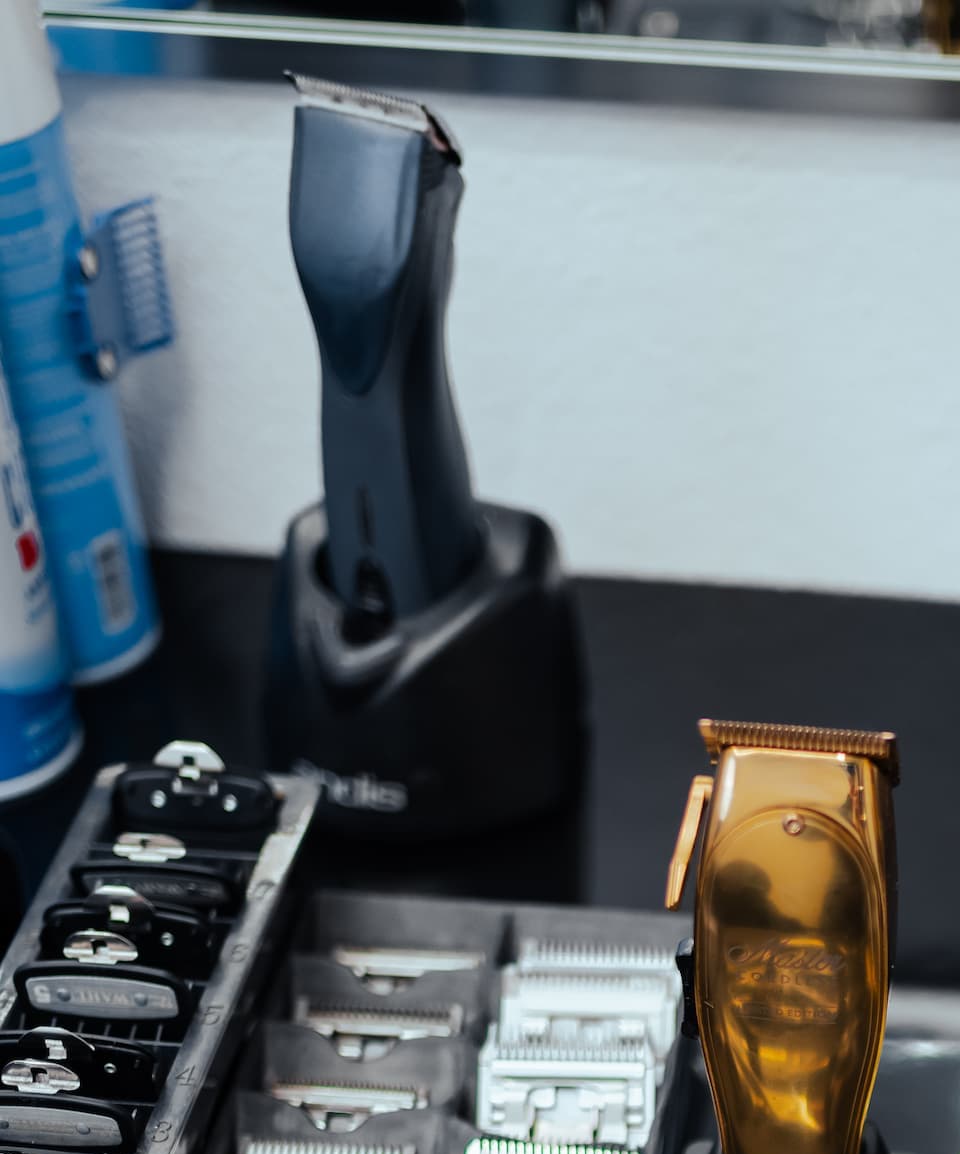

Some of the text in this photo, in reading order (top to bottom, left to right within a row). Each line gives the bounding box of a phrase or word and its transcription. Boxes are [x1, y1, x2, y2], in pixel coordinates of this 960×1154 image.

[229, 943, 248, 964] 6
[202, 1006, 225, 1026] 5
[176, 1064, 196, 1086] 4
[152, 1120, 173, 1143] 3
